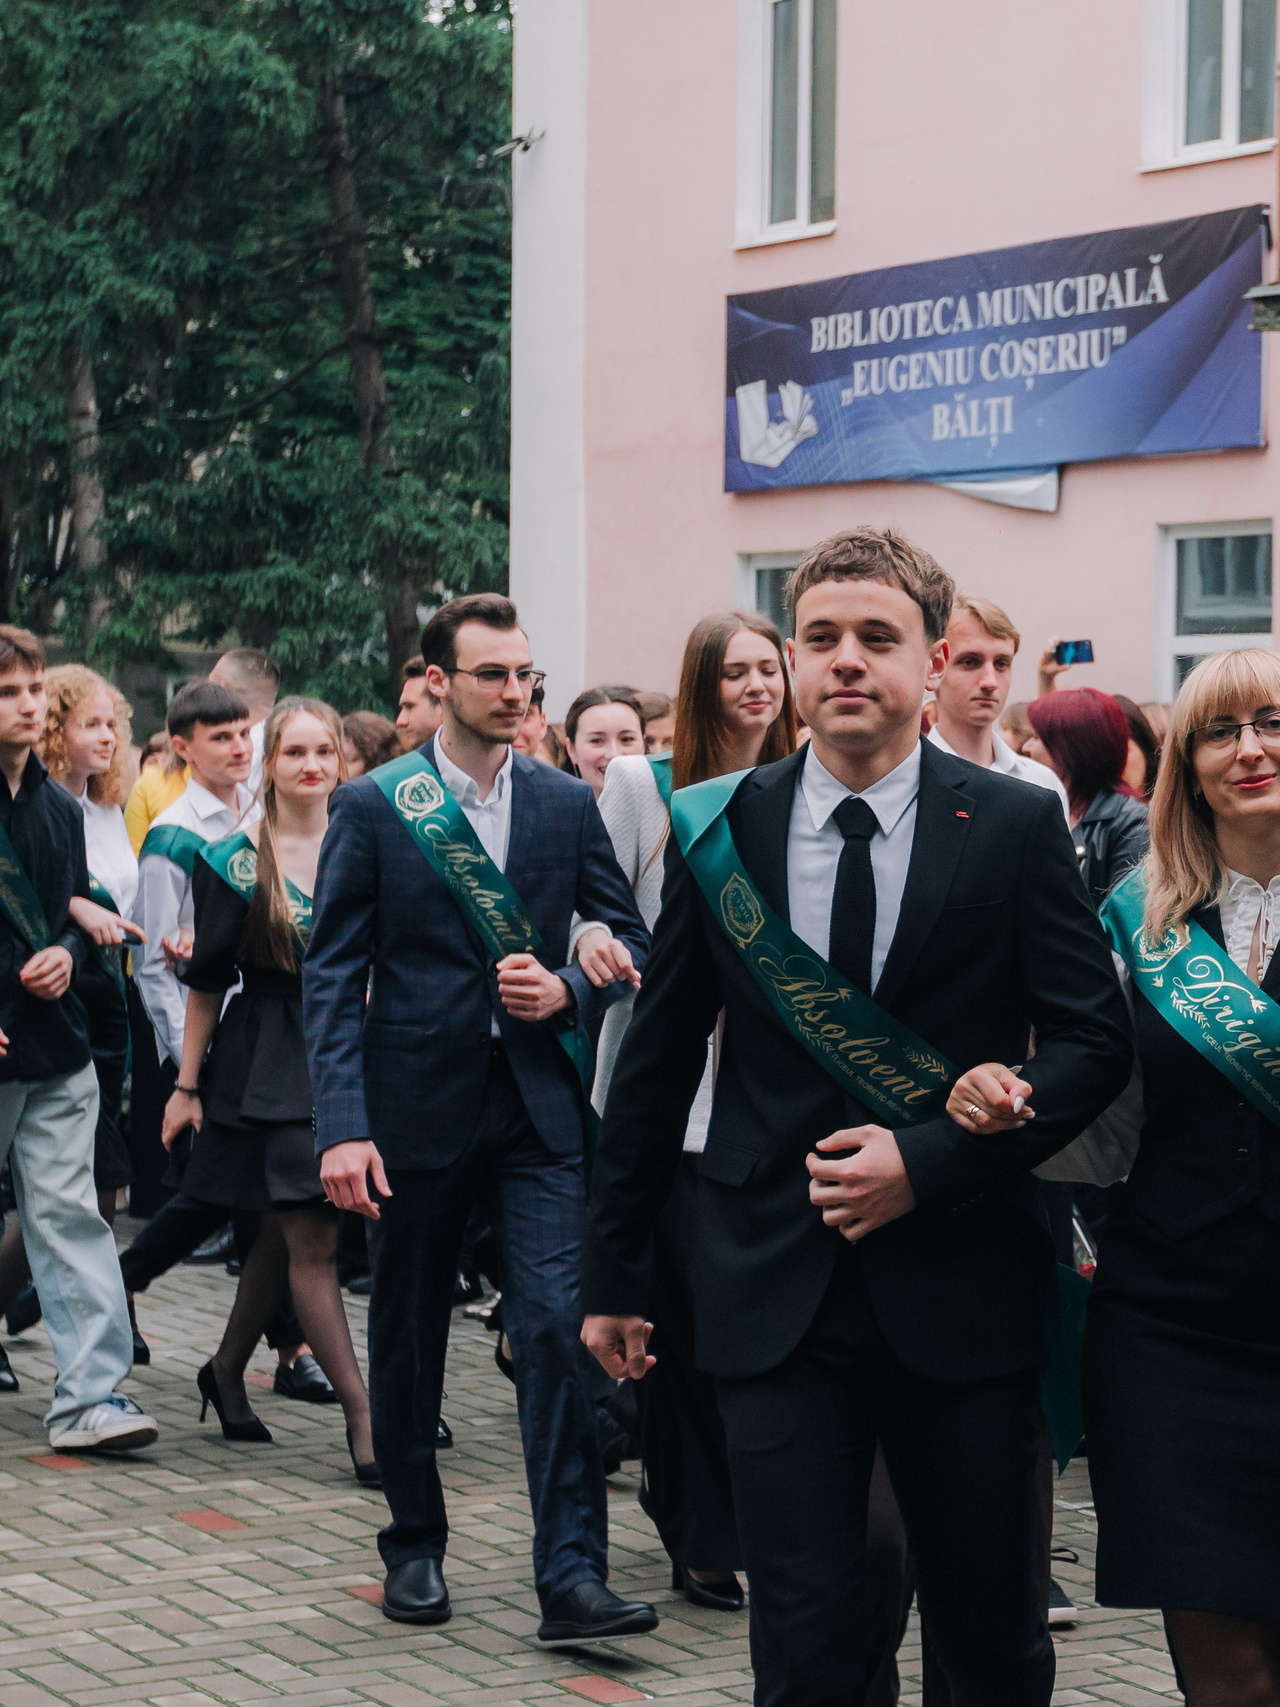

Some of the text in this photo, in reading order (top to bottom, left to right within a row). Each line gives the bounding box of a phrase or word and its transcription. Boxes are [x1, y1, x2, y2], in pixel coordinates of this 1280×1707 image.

[810, 253, 1169, 353] BIBLIOTECA MUNICIPALĂ
[931, 392, 1014, 448] BĂLȚI
[416, 813, 525, 945] Absolvent
[750, 941, 938, 1104] Absolvent
[1202, 1031, 1223, 1053] LICEUL
[1223, 1053, 1252, 1080] TEORETIC
[856, 1076, 888, 1103] TEORETIC
